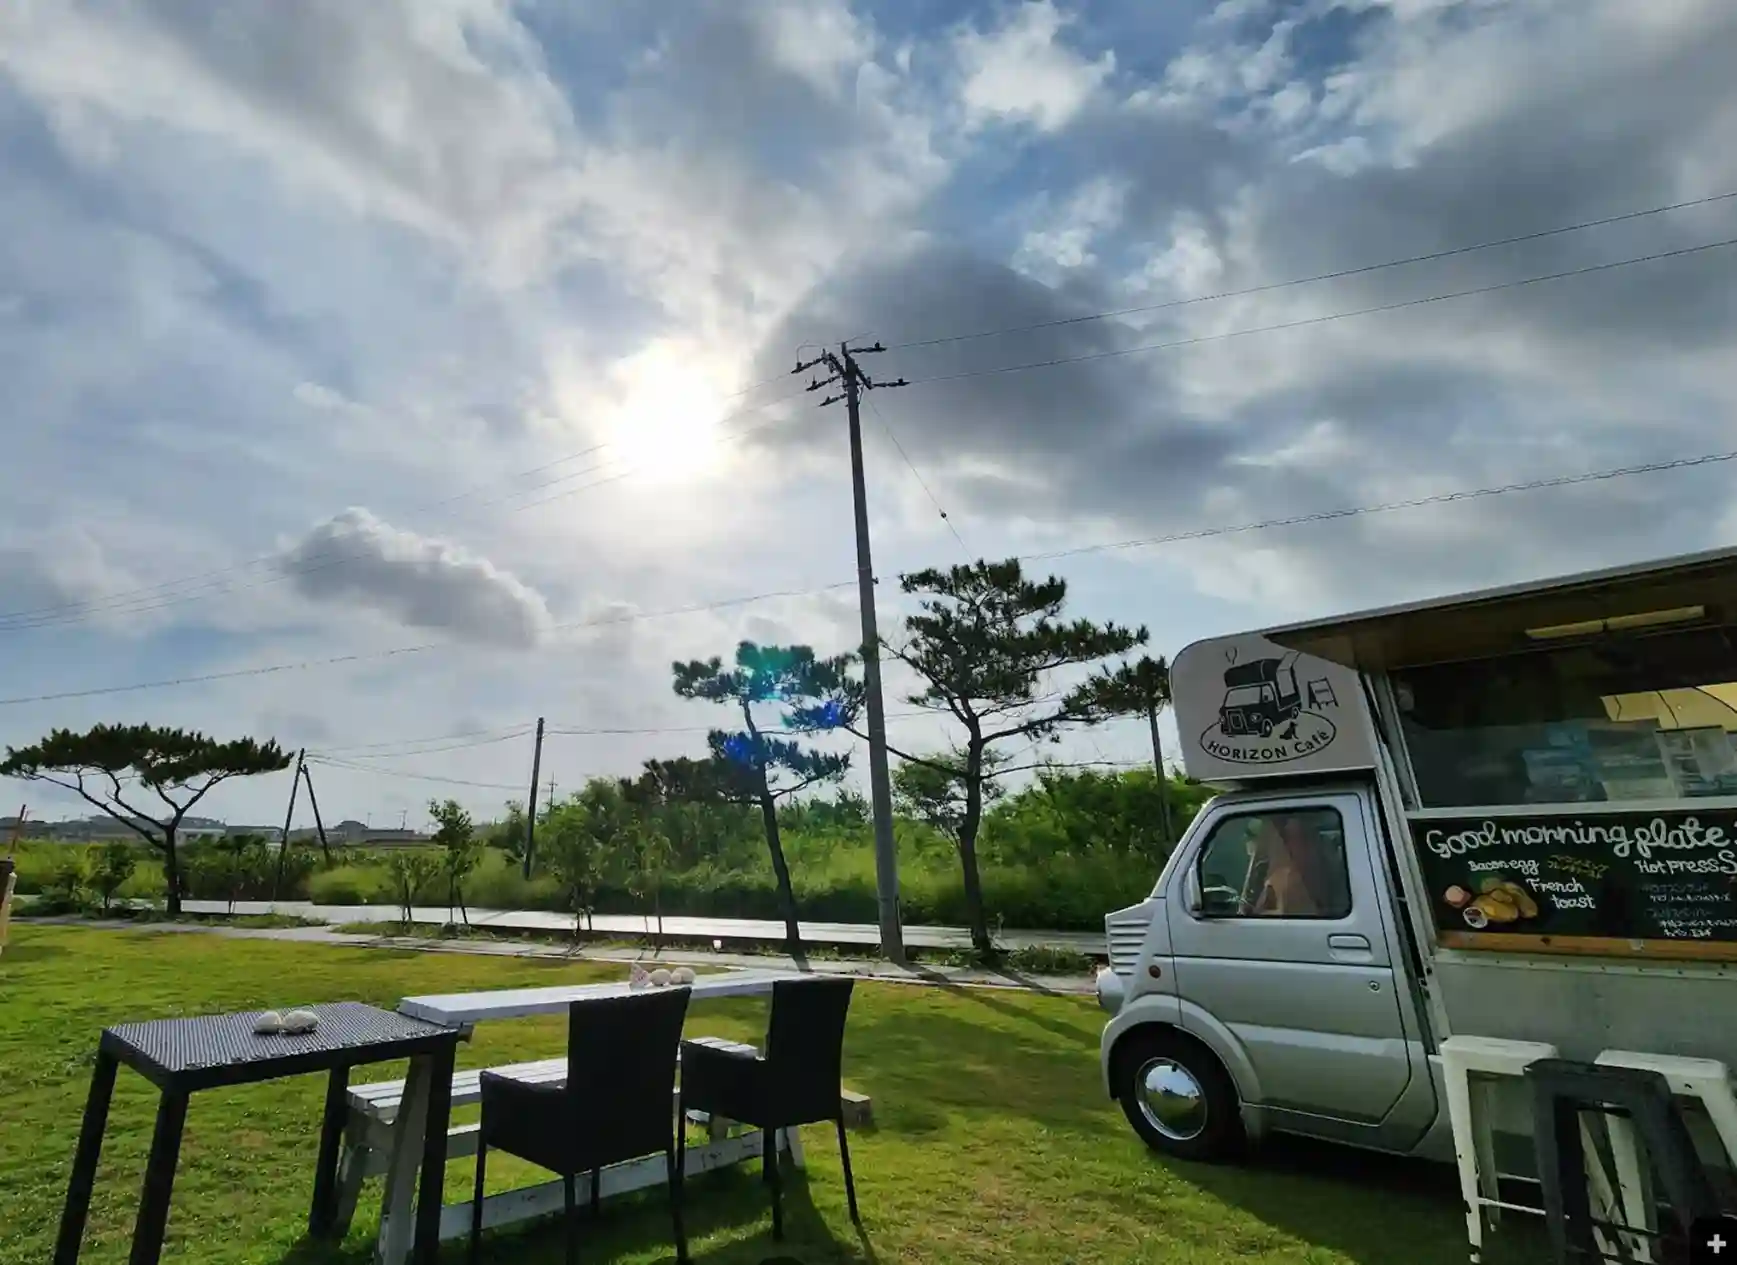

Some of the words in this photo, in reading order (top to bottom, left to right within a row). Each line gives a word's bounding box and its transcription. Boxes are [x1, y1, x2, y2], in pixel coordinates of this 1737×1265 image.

[1207, 741, 1288, 760] HORIZON
[1426, 821, 1500, 858] Good
[1501, 821, 1634, 857] morning
[1634, 816, 1730, 858] plate
[1468, 860, 1509, 871] Bacon
[1509, 860, 1539, 875] egg
[1634, 860, 1666, 874] Hot
[1525, 877, 1585, 893] French
[1551, 894, 1596, 909] toast
